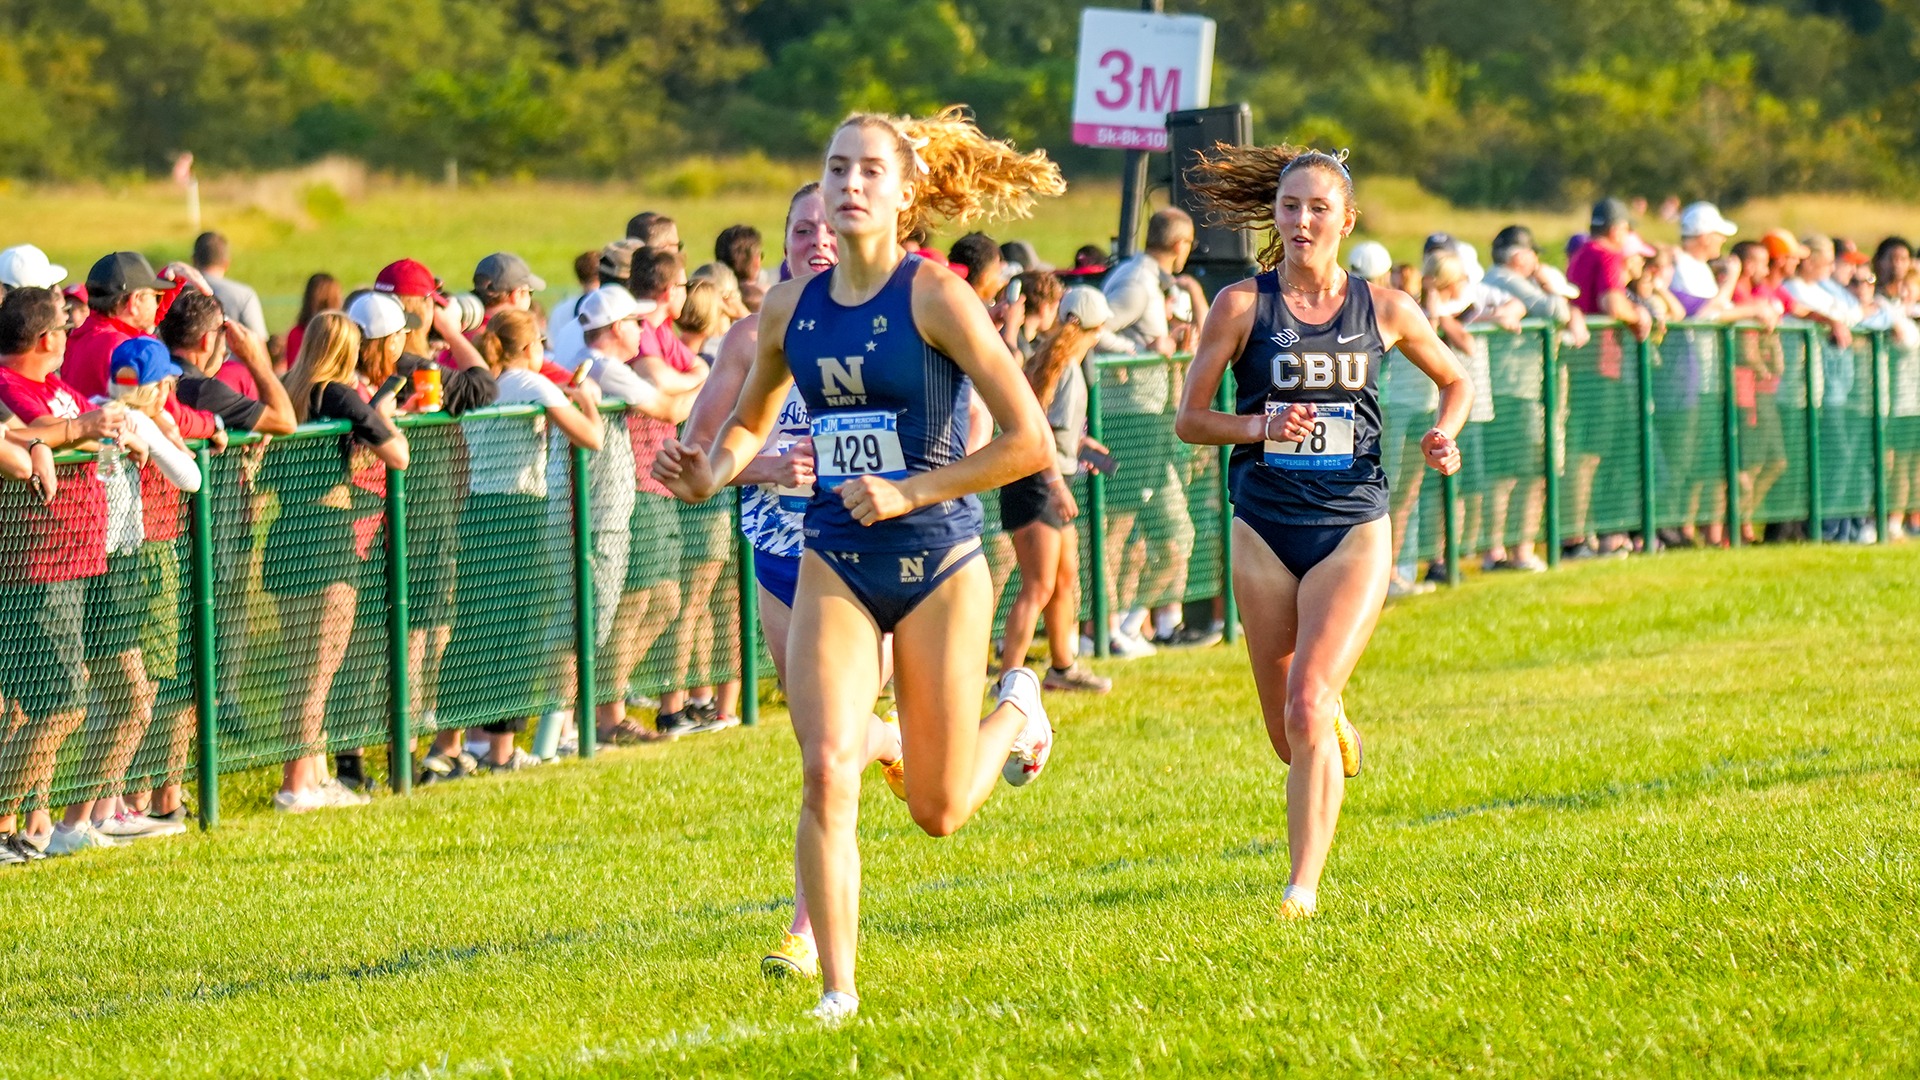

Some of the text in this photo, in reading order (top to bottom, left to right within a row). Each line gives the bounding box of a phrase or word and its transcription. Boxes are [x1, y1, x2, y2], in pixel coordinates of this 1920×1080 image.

[816, 356, 866, 396] N
[1271, 352, 1368, 390] CBU
[825, 395, 868, 407] NAVY
[824, 418, 839, 432] JM
[832, 434, 884, 474] 429
[1274, 458, 1310, 466] SEPTEMBER
[899, 557, 925, 577] N
